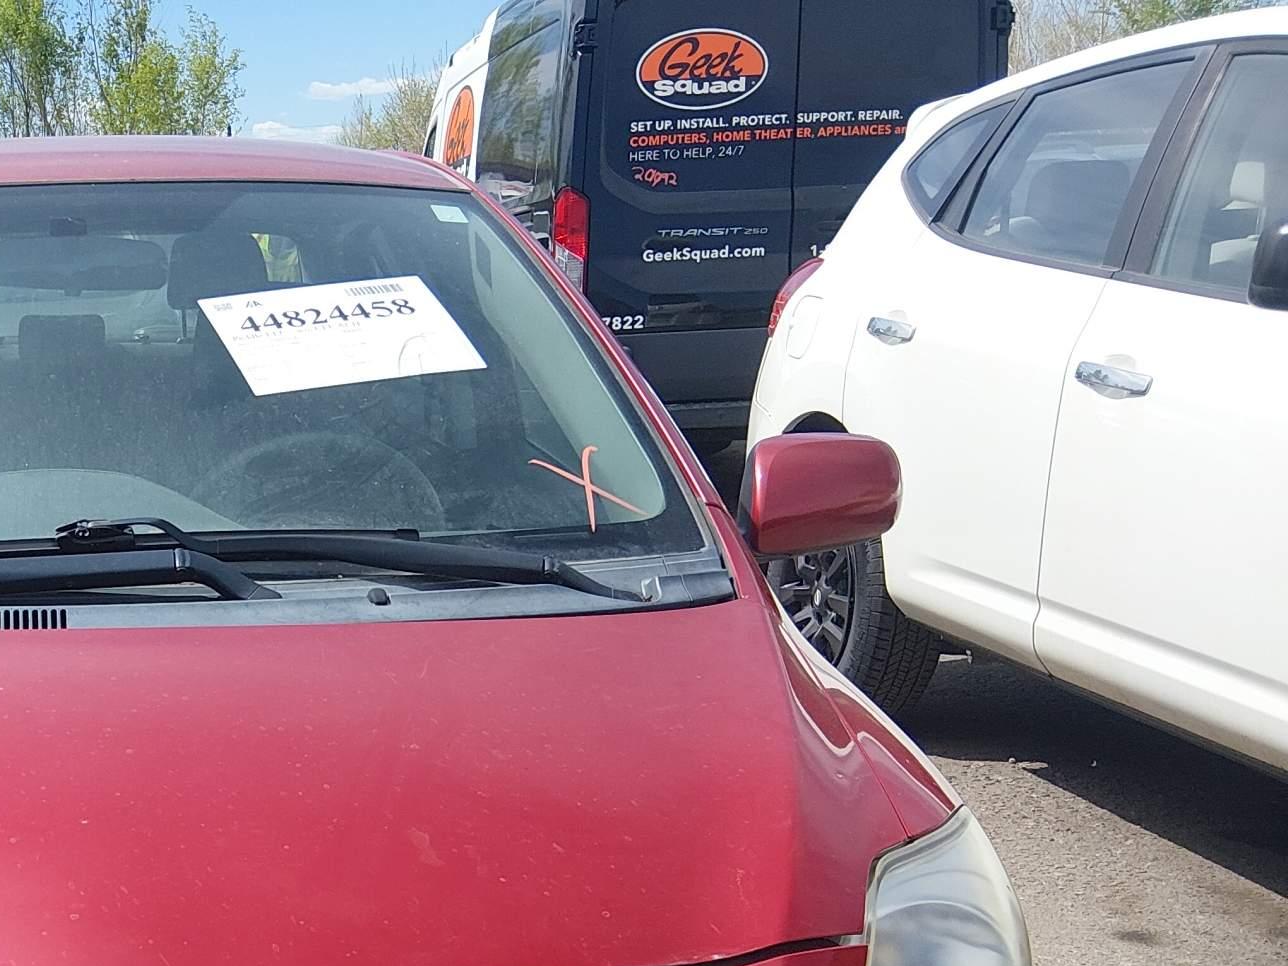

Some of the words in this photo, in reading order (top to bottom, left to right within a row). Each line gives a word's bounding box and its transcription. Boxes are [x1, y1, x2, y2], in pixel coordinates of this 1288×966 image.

[658, 36, 744, 80] Geek
[653, 76, 746, 97] Squad
[630, 121, 653, 133] SET
[655, 119, 674, 131] UP.
[677, 117, 729, 130] INSTALL.
[732, 114, 790, 127] PROTECT.
[796, 111, 855, 123] SUPPORT.
[858, 109, 903, 121] REPAIR.
[629, 132, 710, 147] COMPUTERS,
[713, 130, 751, 143] HOME
[817, 124, 891, 138] APPLIANCES
[629, 149, 660, 162] HERE
[663, 148, 680, 160] TO
[683, 148, 715, 159] HELP,
[718, 145, 745, 157] 24/7
[657, 227, 744, 237] TRANSIT
[744, 227, 769, 235] 250
[642, 245, 766, 263] GeekSquad.com
[240, 298, 416, 332] 44824458
